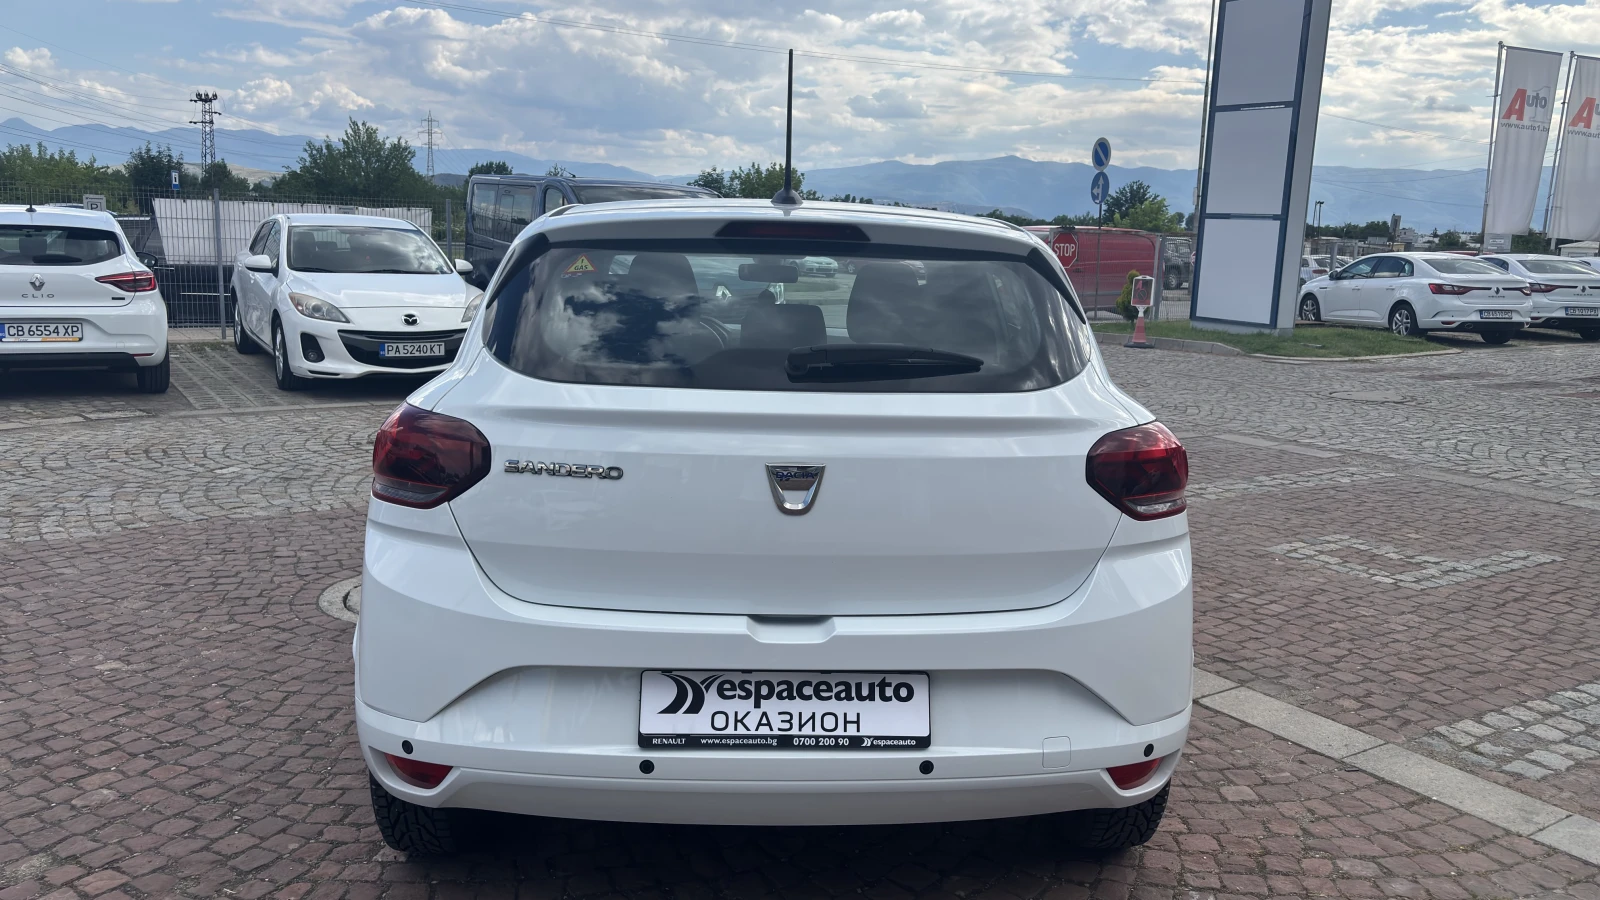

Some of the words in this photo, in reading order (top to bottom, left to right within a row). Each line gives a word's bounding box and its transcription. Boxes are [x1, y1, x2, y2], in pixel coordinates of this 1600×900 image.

[1054, 243, 1076, 257] STOP
[7, 325, 25, 337] CB
[28, 325, 60, 337] 6554
[62, 325, 80, 337] XP
[386, 344, 401, 355] PA
[402, 344, 428, 355] 5240
[429, 343, 443, 354] KT
[504, 459, 624, 480] SANDERO
[775, 471, 815, 479] DACIA
[716, 676, 915, 709] espaceauto
[710, 710, 861, 733] ОКАЗИОН
[700, 737, 778, 746] www.espaceauto.bg
[793, 737, 816, 746] 0700
[818, 737, 835, 746] 200
[837, 737, 850, 746] 90
[872, 738, 916, 747] espaceauto
